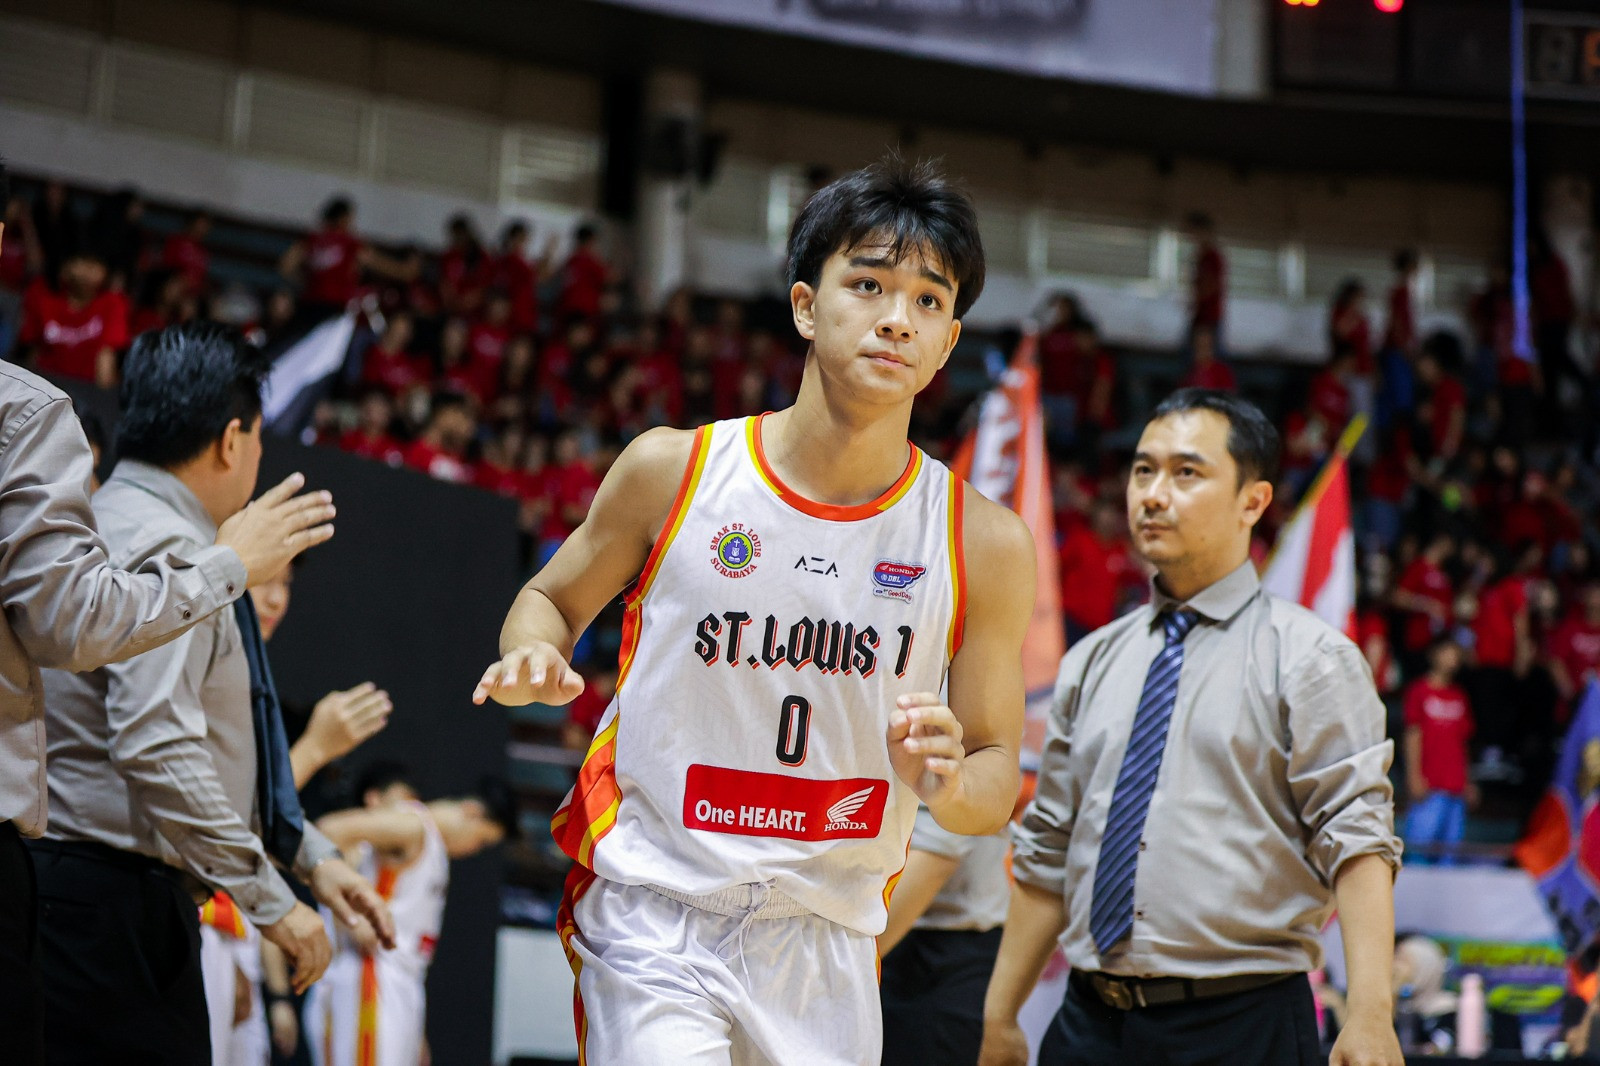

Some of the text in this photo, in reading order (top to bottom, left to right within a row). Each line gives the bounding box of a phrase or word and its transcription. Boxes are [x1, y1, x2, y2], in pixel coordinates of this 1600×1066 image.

[710, 523, 762, 558] SMAK ST. LOUIS
[710, 557, 758, 579] SURABAYA
[888, 567, 915, 575] HONDA
[894, 625, 915, 679] 1
[776, 694, 812, 767] 0
[695, 799, 807, 833] One HEART.
[823, 821, 869, 832] HONDA
